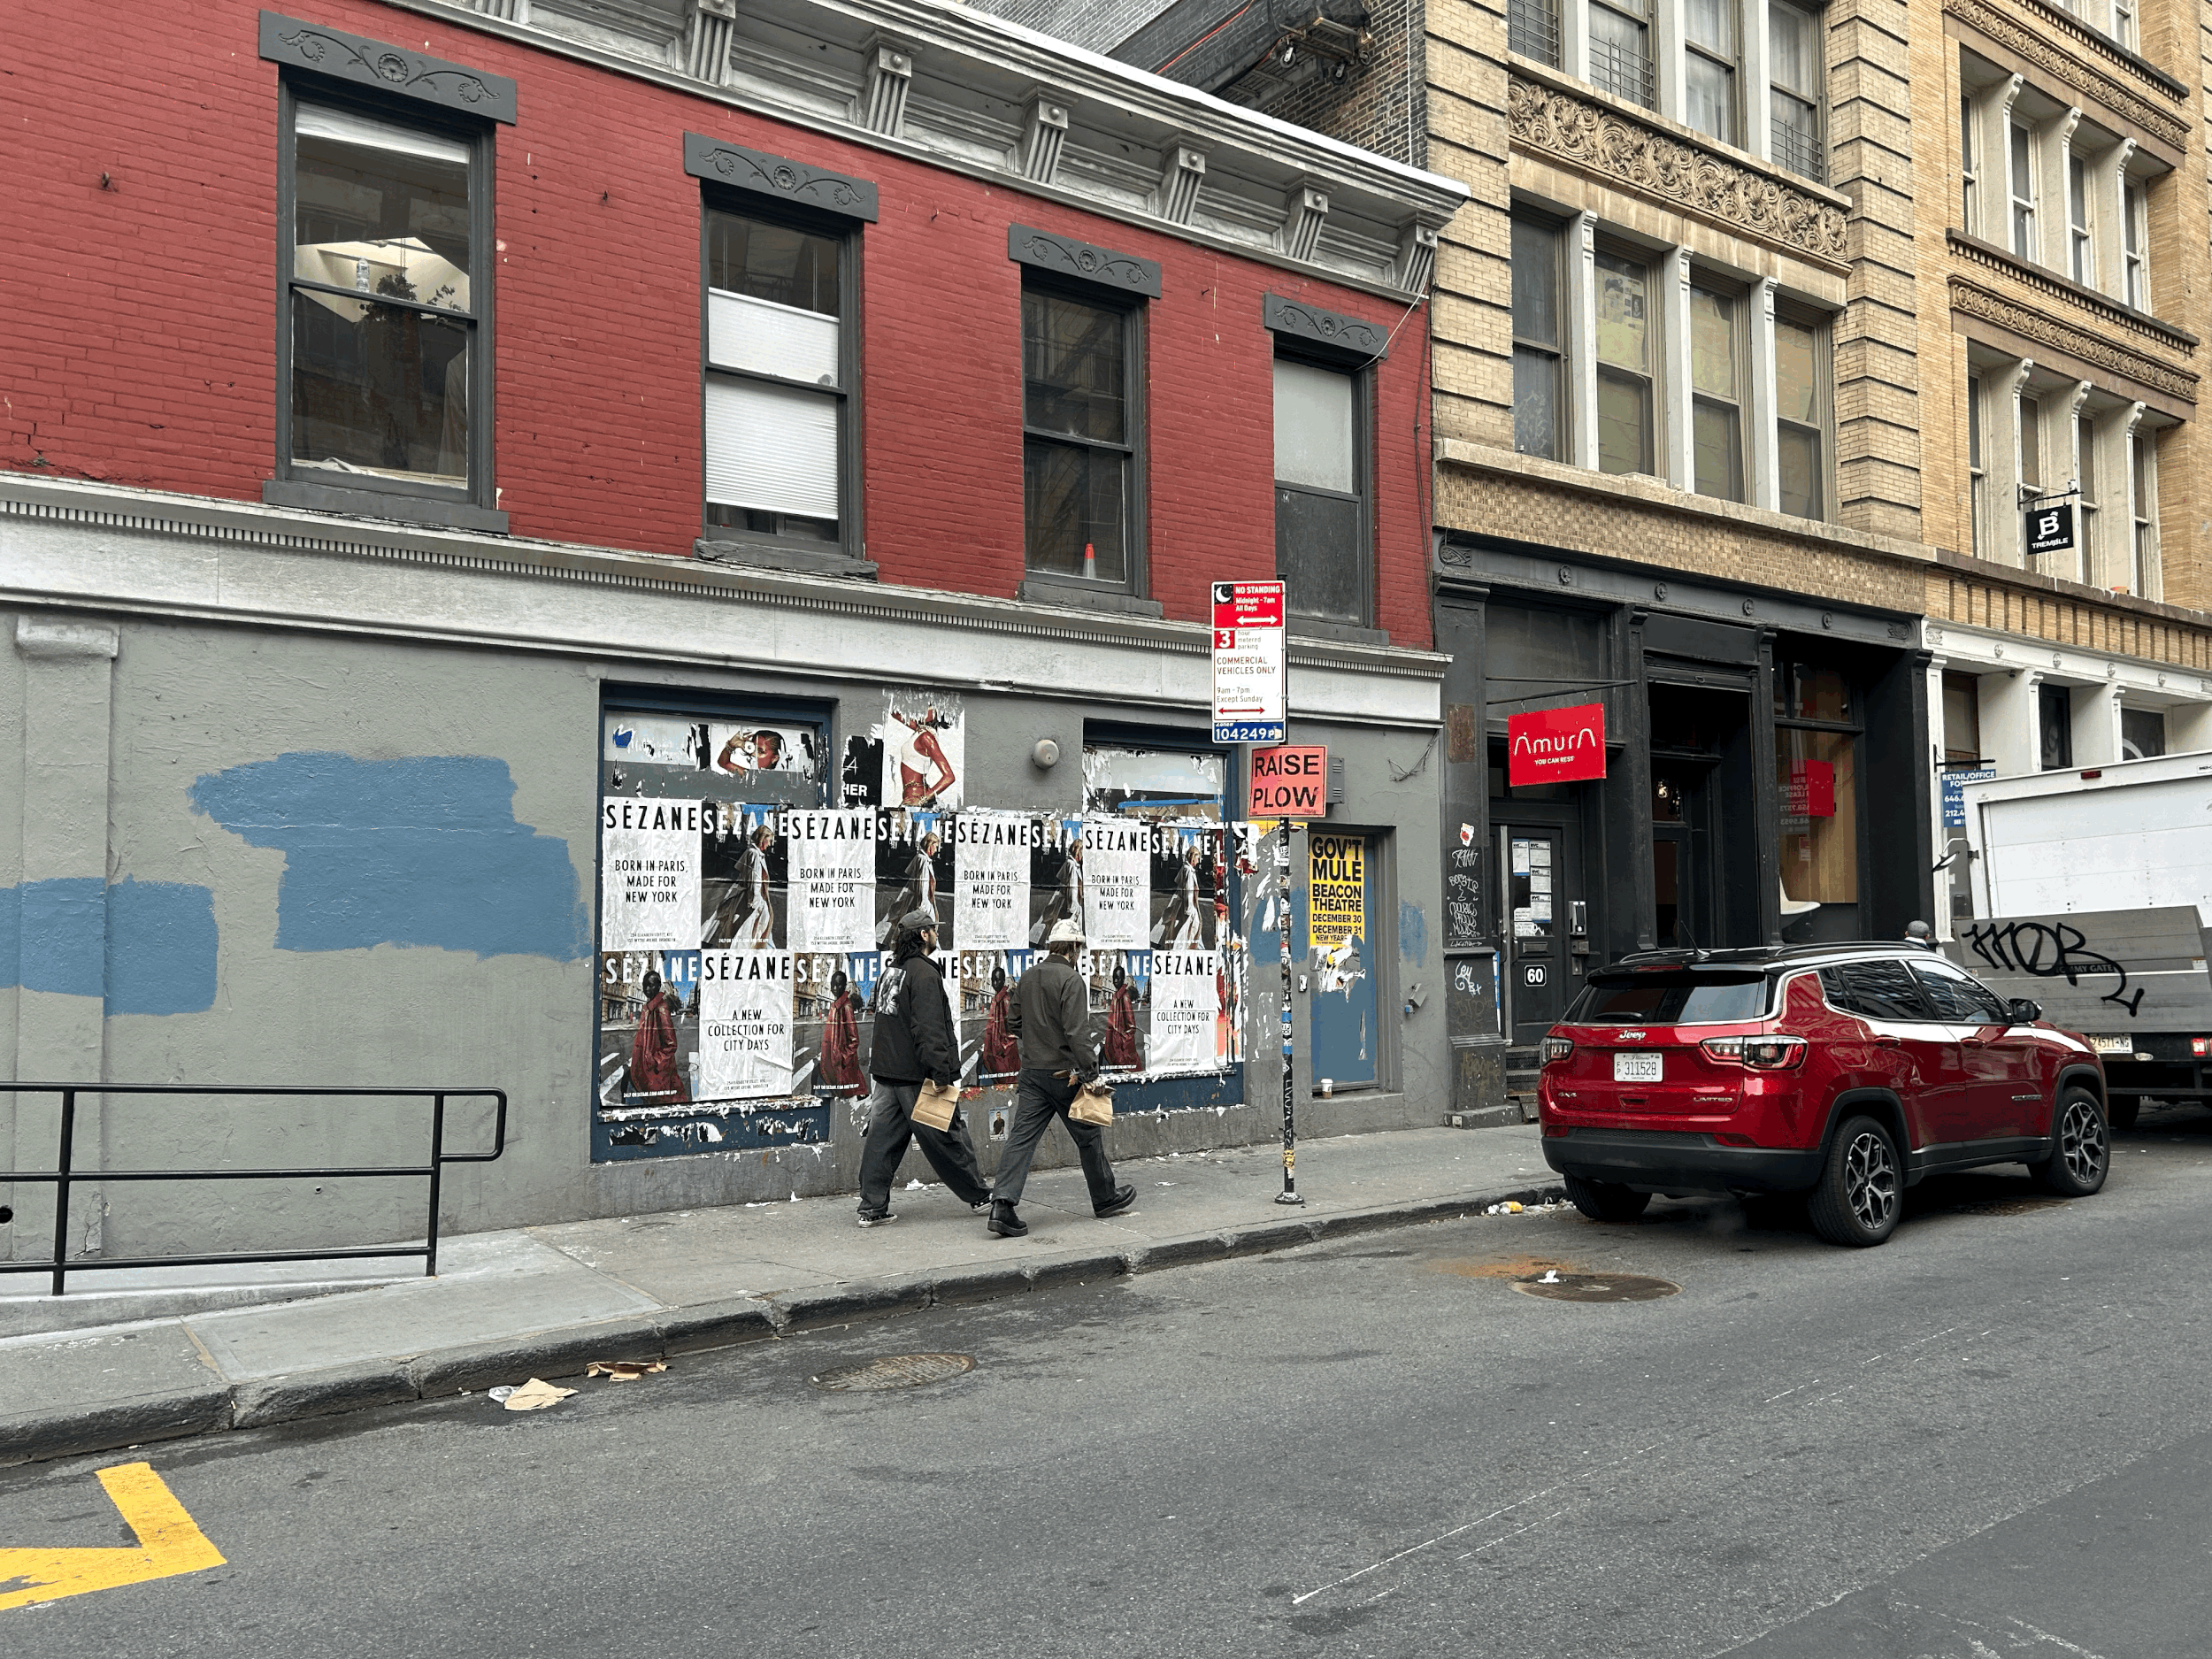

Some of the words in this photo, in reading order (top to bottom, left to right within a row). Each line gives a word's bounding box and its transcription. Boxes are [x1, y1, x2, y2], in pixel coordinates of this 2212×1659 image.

[2032, 537, 2069, 549] TREMBLE
[1218, 631, 1231, 649] 3
[1216, 728, 1266, 741] 104249
[1254, 754, 1320, 778] RAISE
[1942, 772, 1994, 780] RETAIL/OFFICE
[1253, 786, 1318, 809] PLOW
[606, 801, 696, 831] SÉZANE
[792, 813, 872, 840] SÉZANE
[958, 818, 1027, 846] SÉZANE
[1085, 827, 1148, 851] SÉZANE
[1312, 837, 1362, 859] GOV'T
[615, 860, 641, 872] BORN
[646, 860, 655, 872] IN
[658, 860, 688, 872] PARIS,
[1312, 859, 1362, 882] MULE
[800, 868, 822, 879] BORN
[825, 868, 834, 879] IN
[964, 871, 985, 881] BORN
[987, 871, 995, 881] IN
[626, 875, 653, 887] MADE
[657, 875, 677, 887] FOR
[1091, 875, 1110, 885] BORN
[1112, 875, 1119, 885] IN
[810, 883, 833, 894] MADE
[838, 883, 854, 894] FOR
[972, 885, 993, 895] MADE
[996, 885, 1011, 895] FOR
[1100, 887, 1118, 898] MADE
[1121, 887, 1133, 897] FOR
[1312, 884, 1362, 898] BEACON
[626, 891, 647, 902] NEW
[652, 890, 678, 902] YORK
[809, 897, 828, 908] NEW
[833, 896, 856, 908] YORK
[972, 898, 989, 909] NEW
[993, 898, 1011, 909] YORK
[1099, 901, 1113, 910] NEW
[1117, 901, 1134, 910] YORK
[1312, 898, 1362, 912] THEATRE
[1312, 913, 1352, 923] DECEMBER
[1312, 925, 1352, 934] DECEMBER
[1354, 926, 1362, 934] 31
[705, 952, 790, 979] SÉZANE
[1155, 952, 1213, 975] SÉZANE
[1527, 968, 1543, 983] 60
[1173, 999, 1178, 1009] A
[1179, 999, 1194, 1009] NEW
[733, 1010, 738, 1021] A
[741, 1009, 762, 1020] NEW
[1156, 1012, 1195, 1022] COLLECTION
[1198, 1012, 1210, 1022] FOR
[708, 1024, 764, 1037] COLLECTION
[767, 1023, 784, 1035] FOR
[1167, 1025, 1182, 1034] CITY
[1184, 1025, 1200, 1034] DAYS
[1619, 1030, 1646, 1041] Jeep
[724, 1040, 744, 1052] CITY
[748, 1039, 769, 1051] DAYS
[1624, 1062, 1656, 1075] 311528
